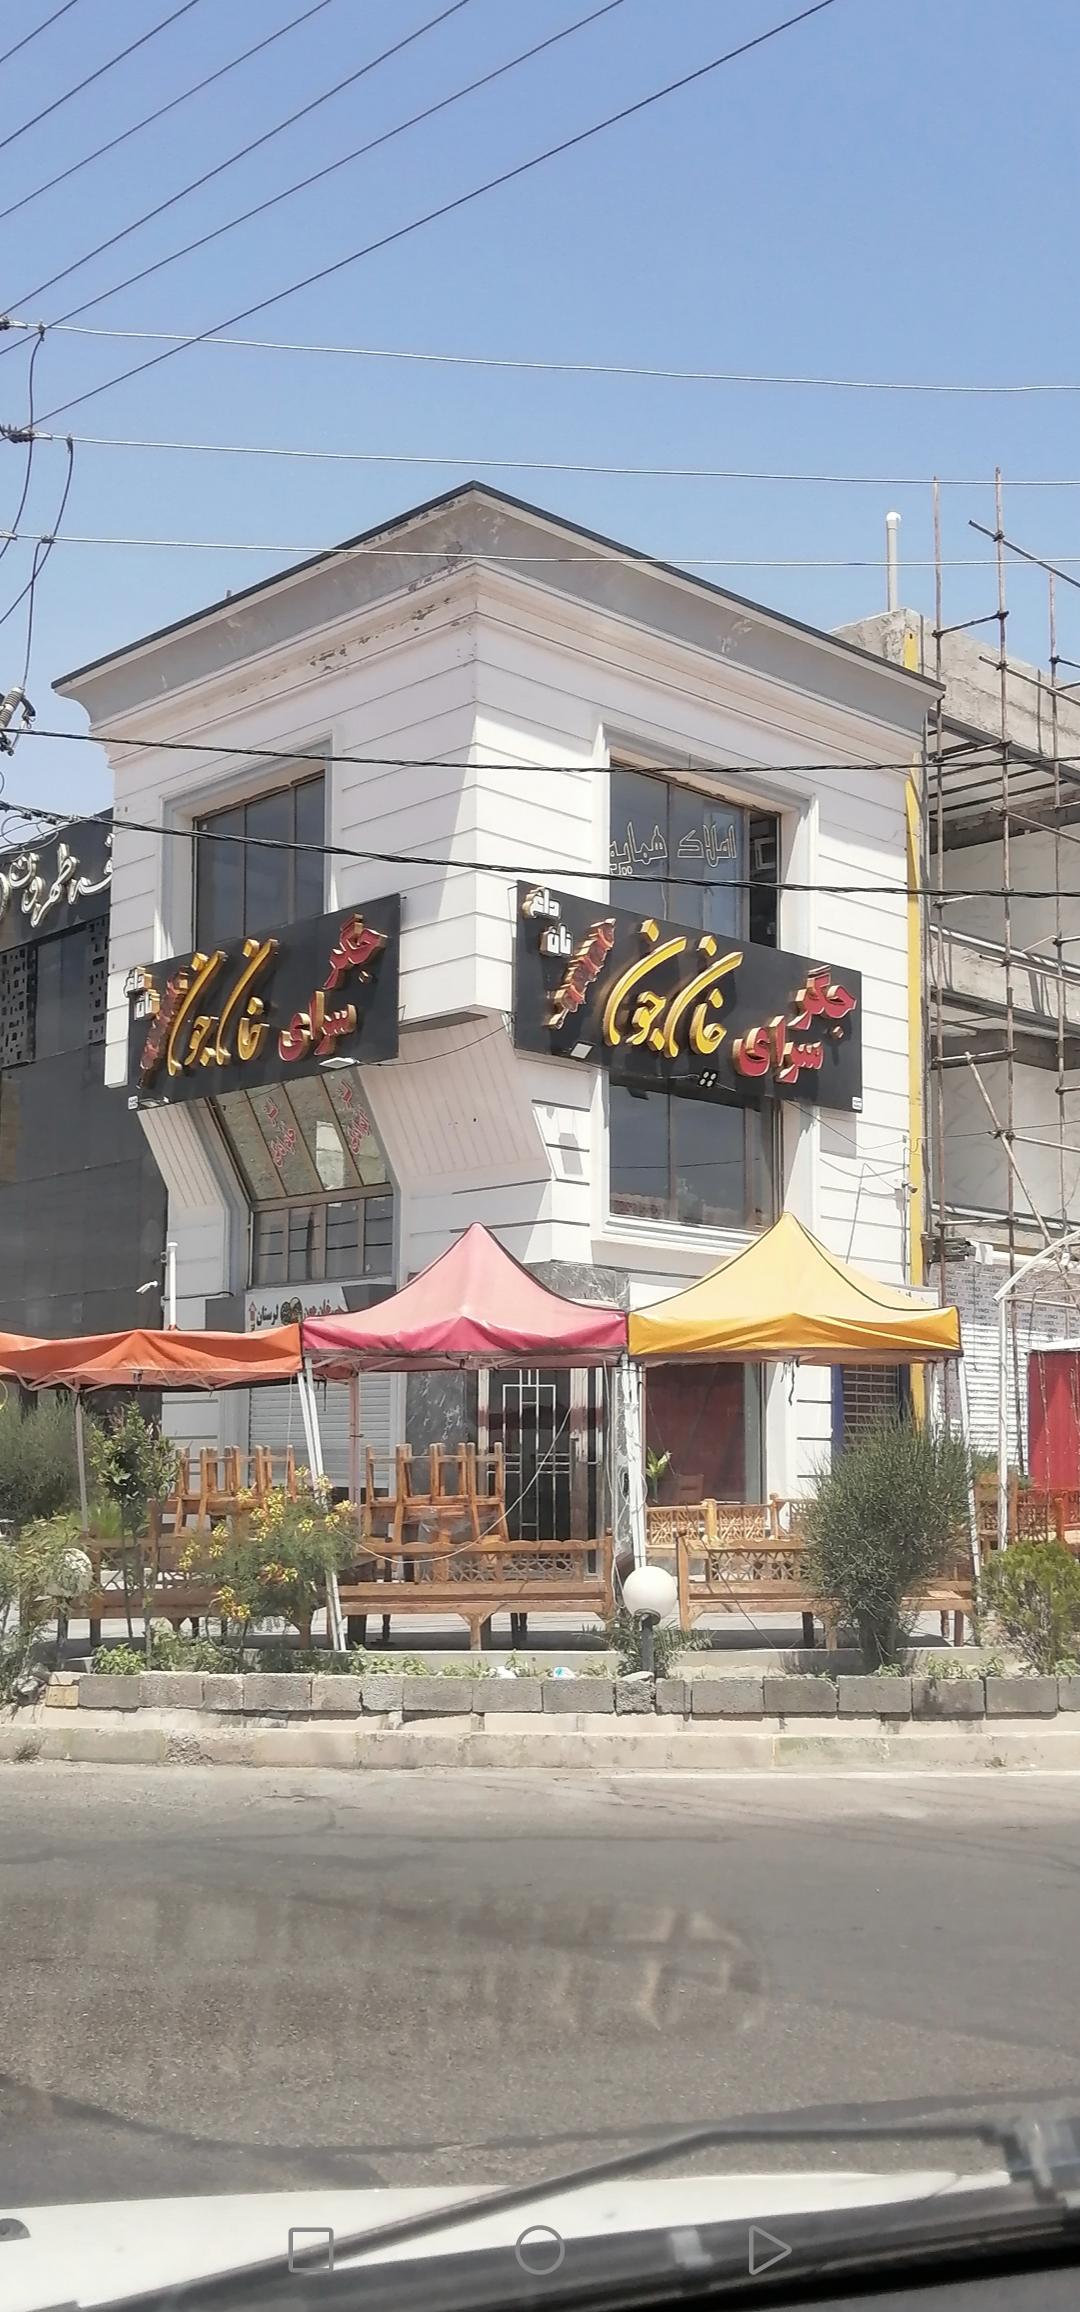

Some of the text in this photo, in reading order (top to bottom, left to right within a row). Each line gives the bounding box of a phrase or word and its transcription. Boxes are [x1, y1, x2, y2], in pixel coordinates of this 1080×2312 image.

[677, 824, 737, 868] املاک
[522, 886, 561, 918] داغ
[323, 912, 388, 990] جگر
[540, 923, 574, 957] نان
[278, 990, 358, 1062] سرای
[788, 964, 857, 1039] جگر
[732, 1015, 825, 1084] سرای
[256, 1303, 279, 1326] لرستان
